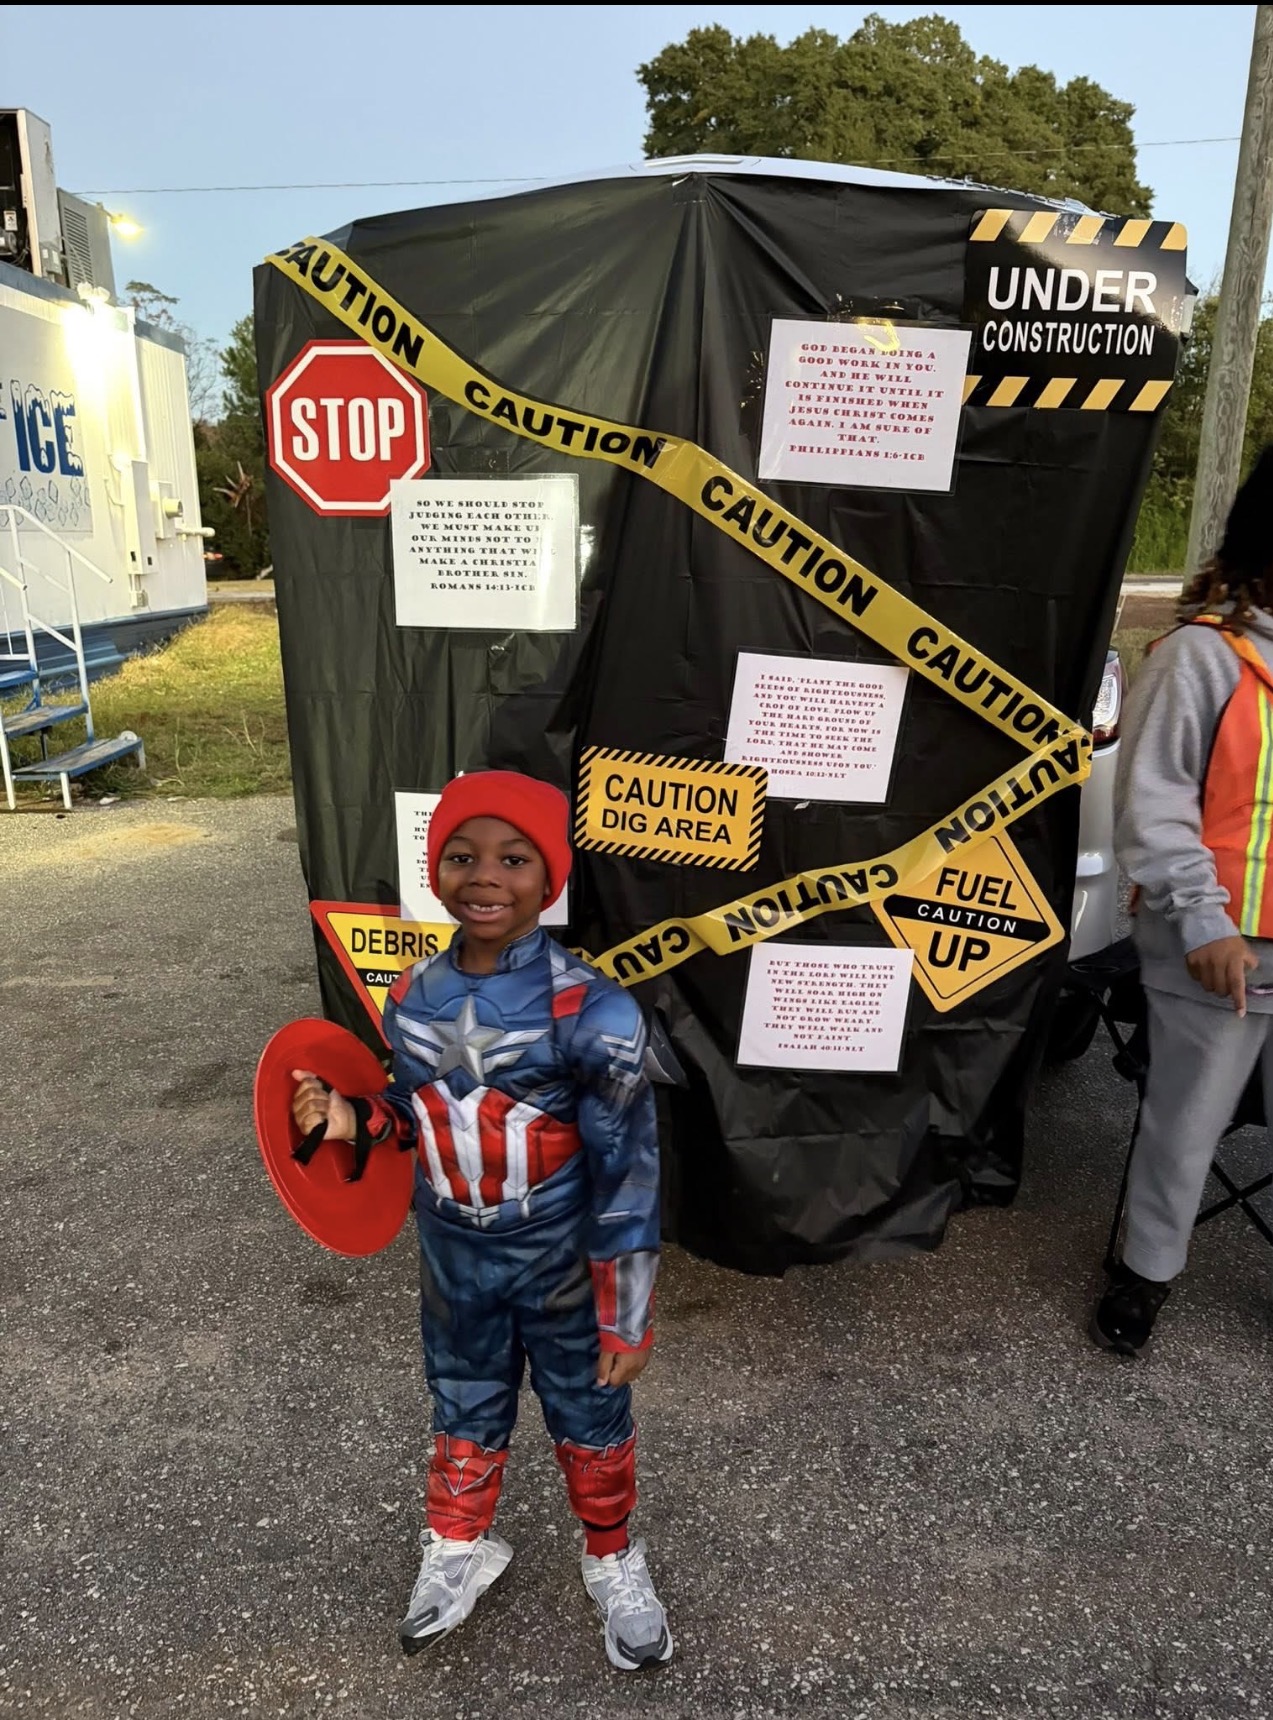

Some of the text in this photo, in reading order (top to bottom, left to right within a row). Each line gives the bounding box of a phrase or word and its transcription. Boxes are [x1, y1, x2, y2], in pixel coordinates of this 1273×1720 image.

[987, 266, 1157, 313] UNDER
[982, 320, 1155, 355] CONSTRUCTION
[801, 342, 936, 360] GOD BEGAN DOING A
[798, 355, 936, 373] GOOD WORK IN YOU.
[820, 369, 912, 384] AND HE WILL
[785, 379, 944, 399] CONTINUE IT UNTIL IT
[798, 393, 928, 411] IS FINISHED WHEN
[788, 404, 934, 424] JESUS CHRIST COMES
[10, 379, 84, 477] ICE
[290, 397, 405, 461] STOP
[464, 380, 667, 469] CAUTION
[788, 417, 932, 436] AGAIN. I AM SURE OF
[837, 434, 880, 444] THAT.
[789, 444, 880, 459] PHILIPPIANS
[416, 499, 544, 510] SO WE SHOULD STOP
[408, 510, 463, 520] JUDGING
[466, 511, 500, 521] EACH
[420, 522, 440, 531] WE
[442, 523, 479, 532] MUST
[482, 523, 522, 532] MAKE
[411, 534, 437, 543] OUR
[441, 534, 481, 543] MINDS
[485, 535, 511, 544] NOT
[514, 535, 531, 544] TO
[700, 475, 879, 617] CAUTION
[409, 545, 475, 555] ANYTHING
[479, 546, 517, 555] THAT
[418, 557, 538, 567] MAKE A CHRISTIA
[437, 569, 528, 578] BROTHER SIN.
[430, 582, 482, 591] ROMANS
[605, 774, 738, 817] CAUTION
[601, 808, 732, 844] DIG AREA
[935, 867, 1017, 911] FUEL
[724, 863, 899, 942] CAUTION
[917, 904, 1018, 933] CAUTION
[352, 927, 438, 957] DEBRIS
[928, 930, 990, 972] UP
[612, 926, 690, 982] CAU
